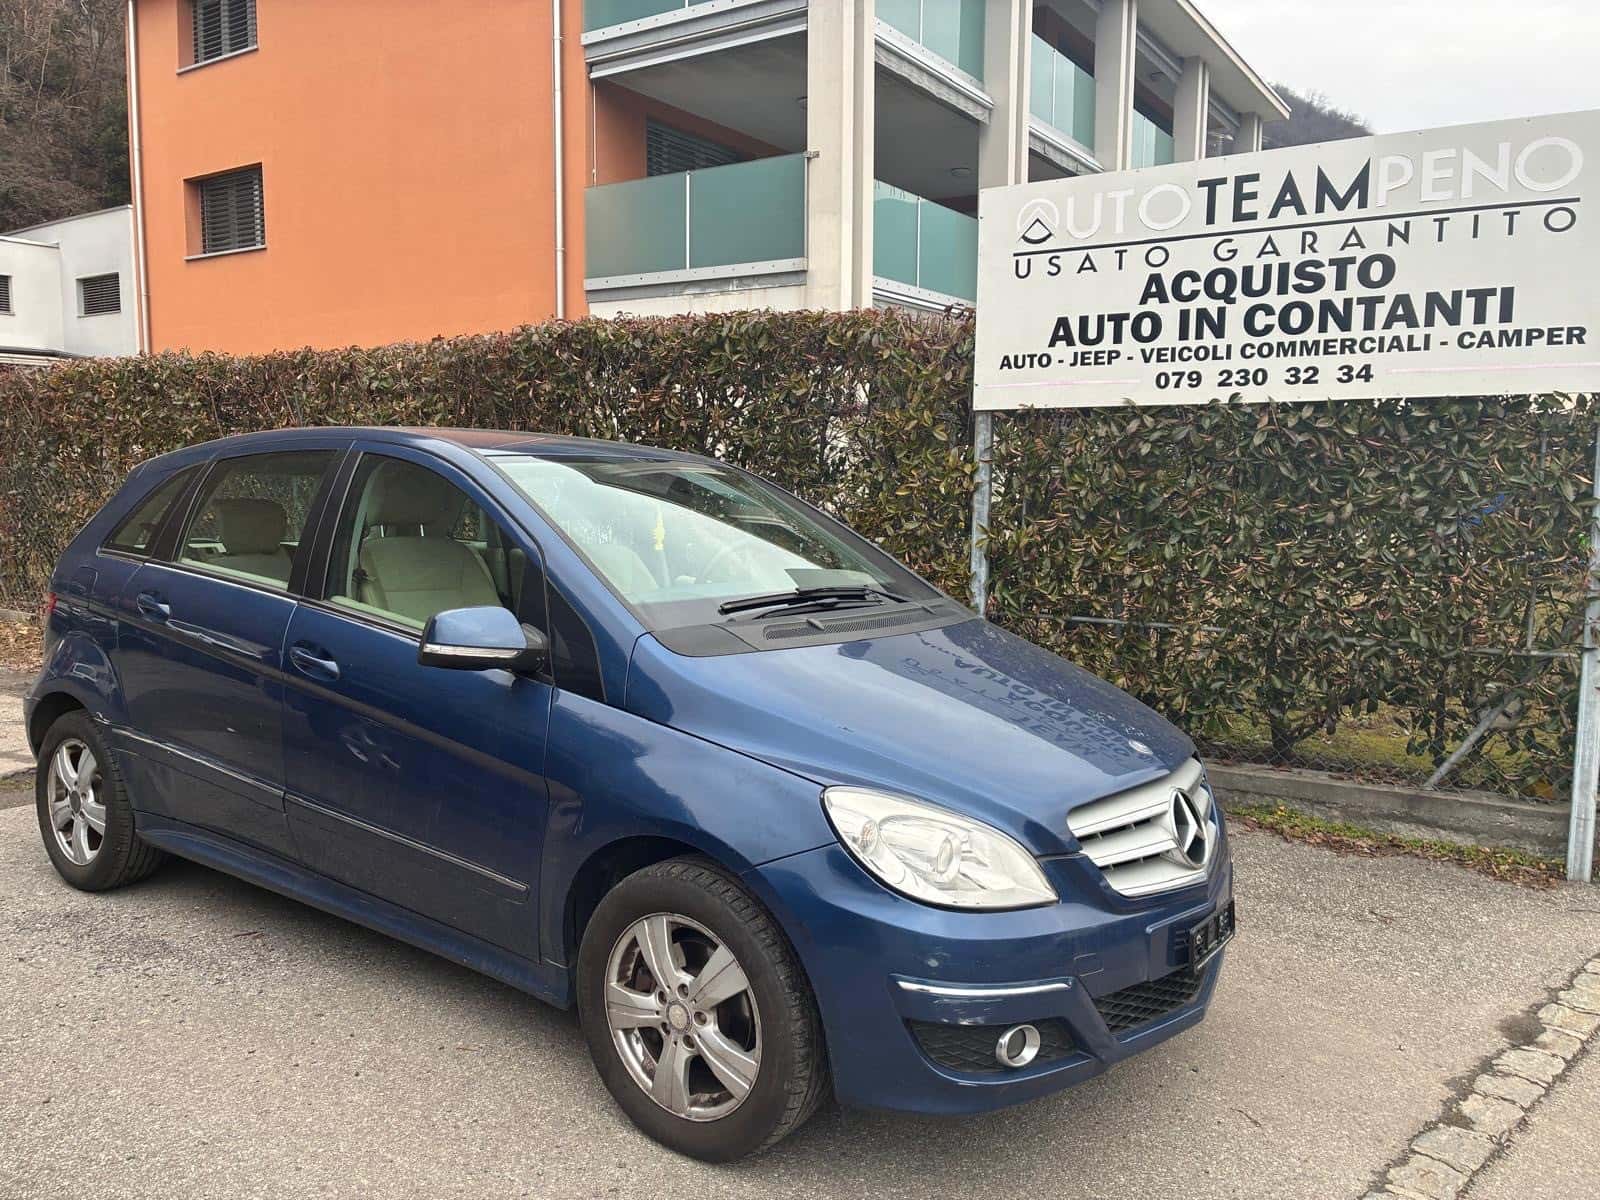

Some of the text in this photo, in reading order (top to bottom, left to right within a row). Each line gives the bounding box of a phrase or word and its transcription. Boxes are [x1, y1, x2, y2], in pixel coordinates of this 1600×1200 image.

[1014, 206, 1578, 280] USATO GARANTITO
[1138, 252, 1397, 306] ACQUISTO
[1047, 285, 1515, 348] AUTO IN CONTANTI
[999, 352, 1052, 371] AUTO
[1069, 349, 1122, 368] JEEP
[1140, 343, 1232, 365] VEICOLI
[1239, 332, 1432, 360] COMMERCIALI
[1456, 325, 1588, 351] CAMPER
[1154, 363, 1375, 390] 079 230 32 34
